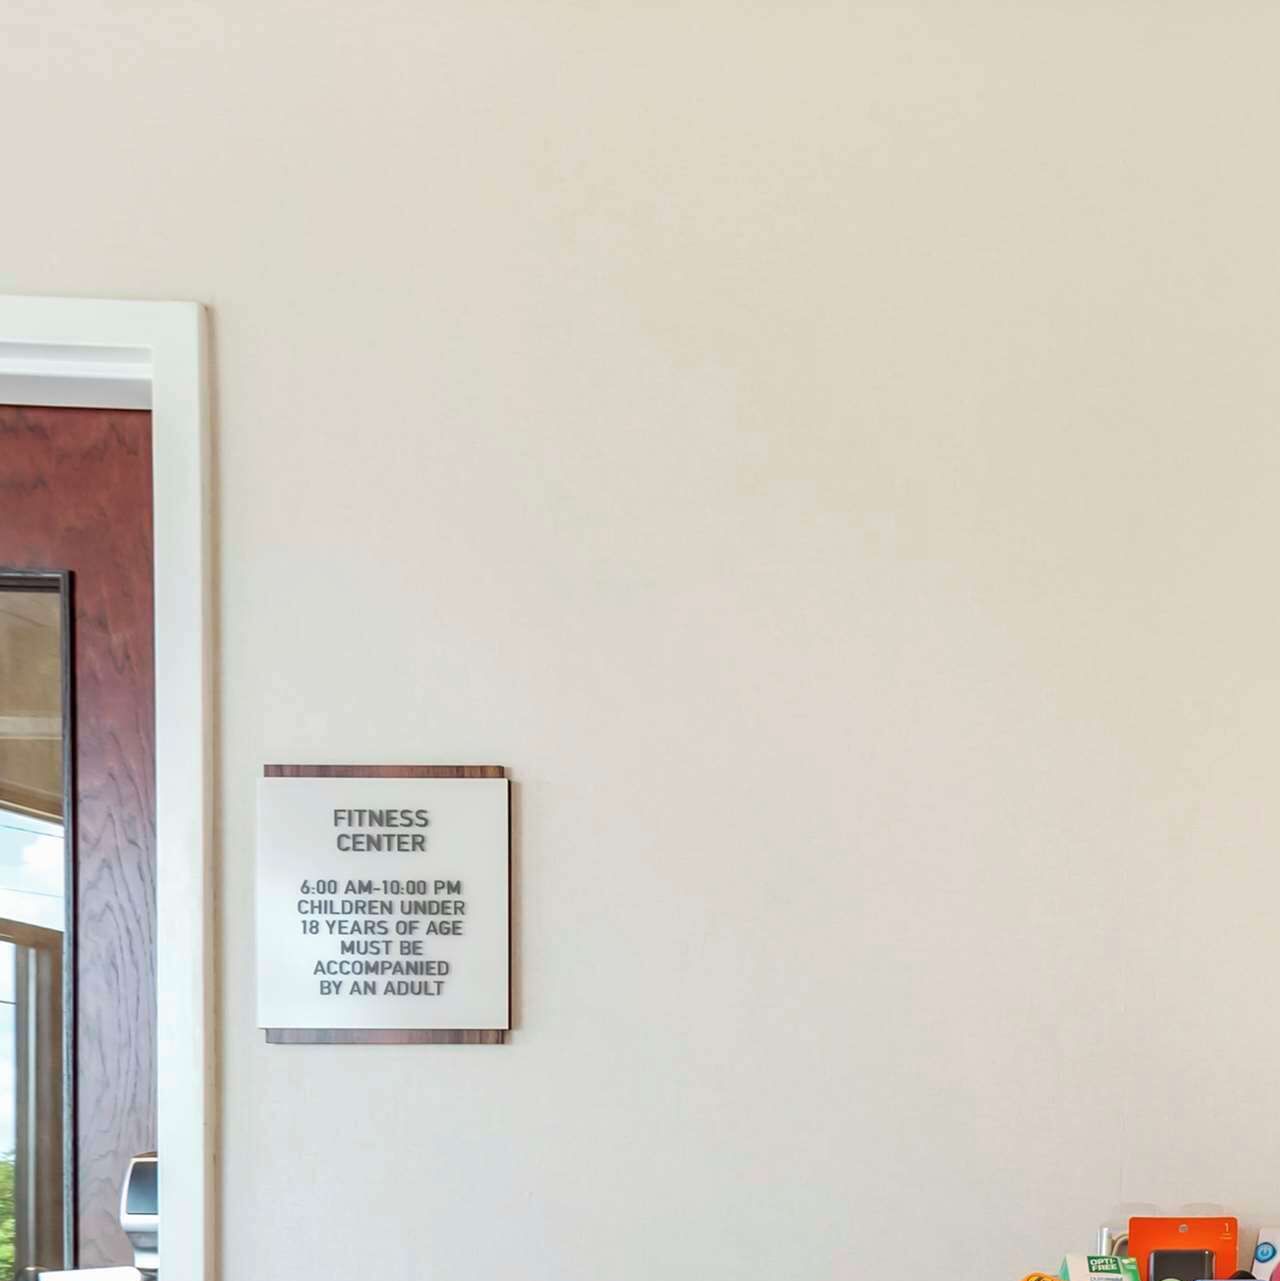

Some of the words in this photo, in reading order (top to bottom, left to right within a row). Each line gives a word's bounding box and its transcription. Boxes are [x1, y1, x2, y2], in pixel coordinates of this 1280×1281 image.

[333, 809, 429, 828] FITNESS
[336, 833, 427, 852] CENTER
[299, 879, 338, 896] 6:00
[343, 880, 427, 896] AM-10:00
[433, 880, 462, 896] PM
[297, 899, 393, 916] CHILDREN
[400, 900, 465, 916] UNDER
[301, 920, 320, 936] 18
[325, 920, 389, 936] YEARS
[395, 920, 419, 936] OF
[425, 920, 463, 936] AGE
[340, 940, 393, 956] MUST
[399, 940, 424, 956] BE
[313, 960, 450, 977] ACCOMPANIED
[319, 980, 343, 997] BY
[349, 980, 377, 997] AN
[383, 980, 445, 997] ADULT
[1091, 1264, 1118, 1272] FREE
